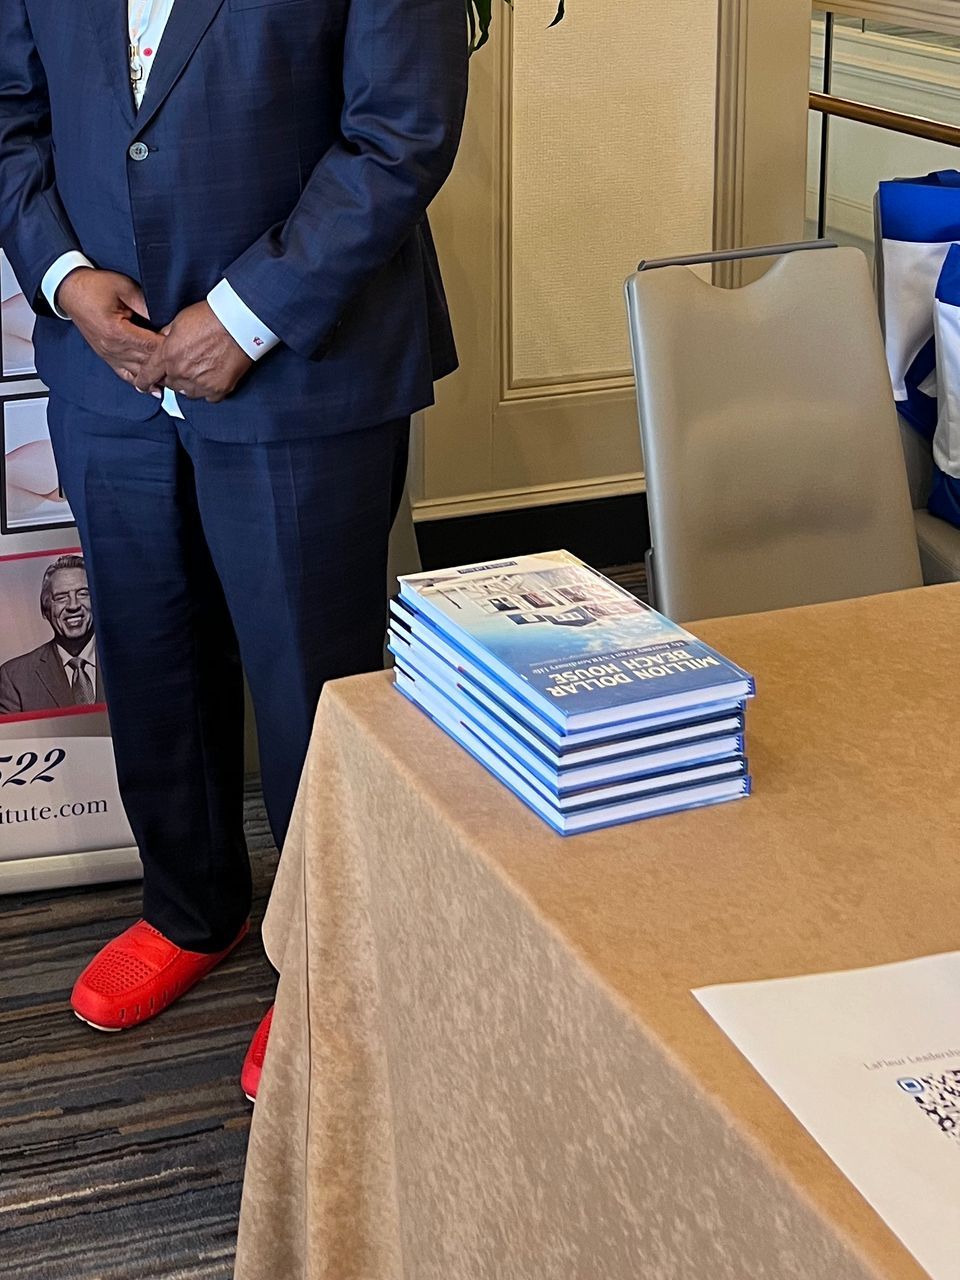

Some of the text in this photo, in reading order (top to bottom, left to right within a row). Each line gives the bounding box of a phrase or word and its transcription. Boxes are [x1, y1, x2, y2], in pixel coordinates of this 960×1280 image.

[621, 649, 694, 670] BEACH
[546, 655, 721, 698] MILLION DOLLAR
[548, 663, 620, 685] HOUSE
